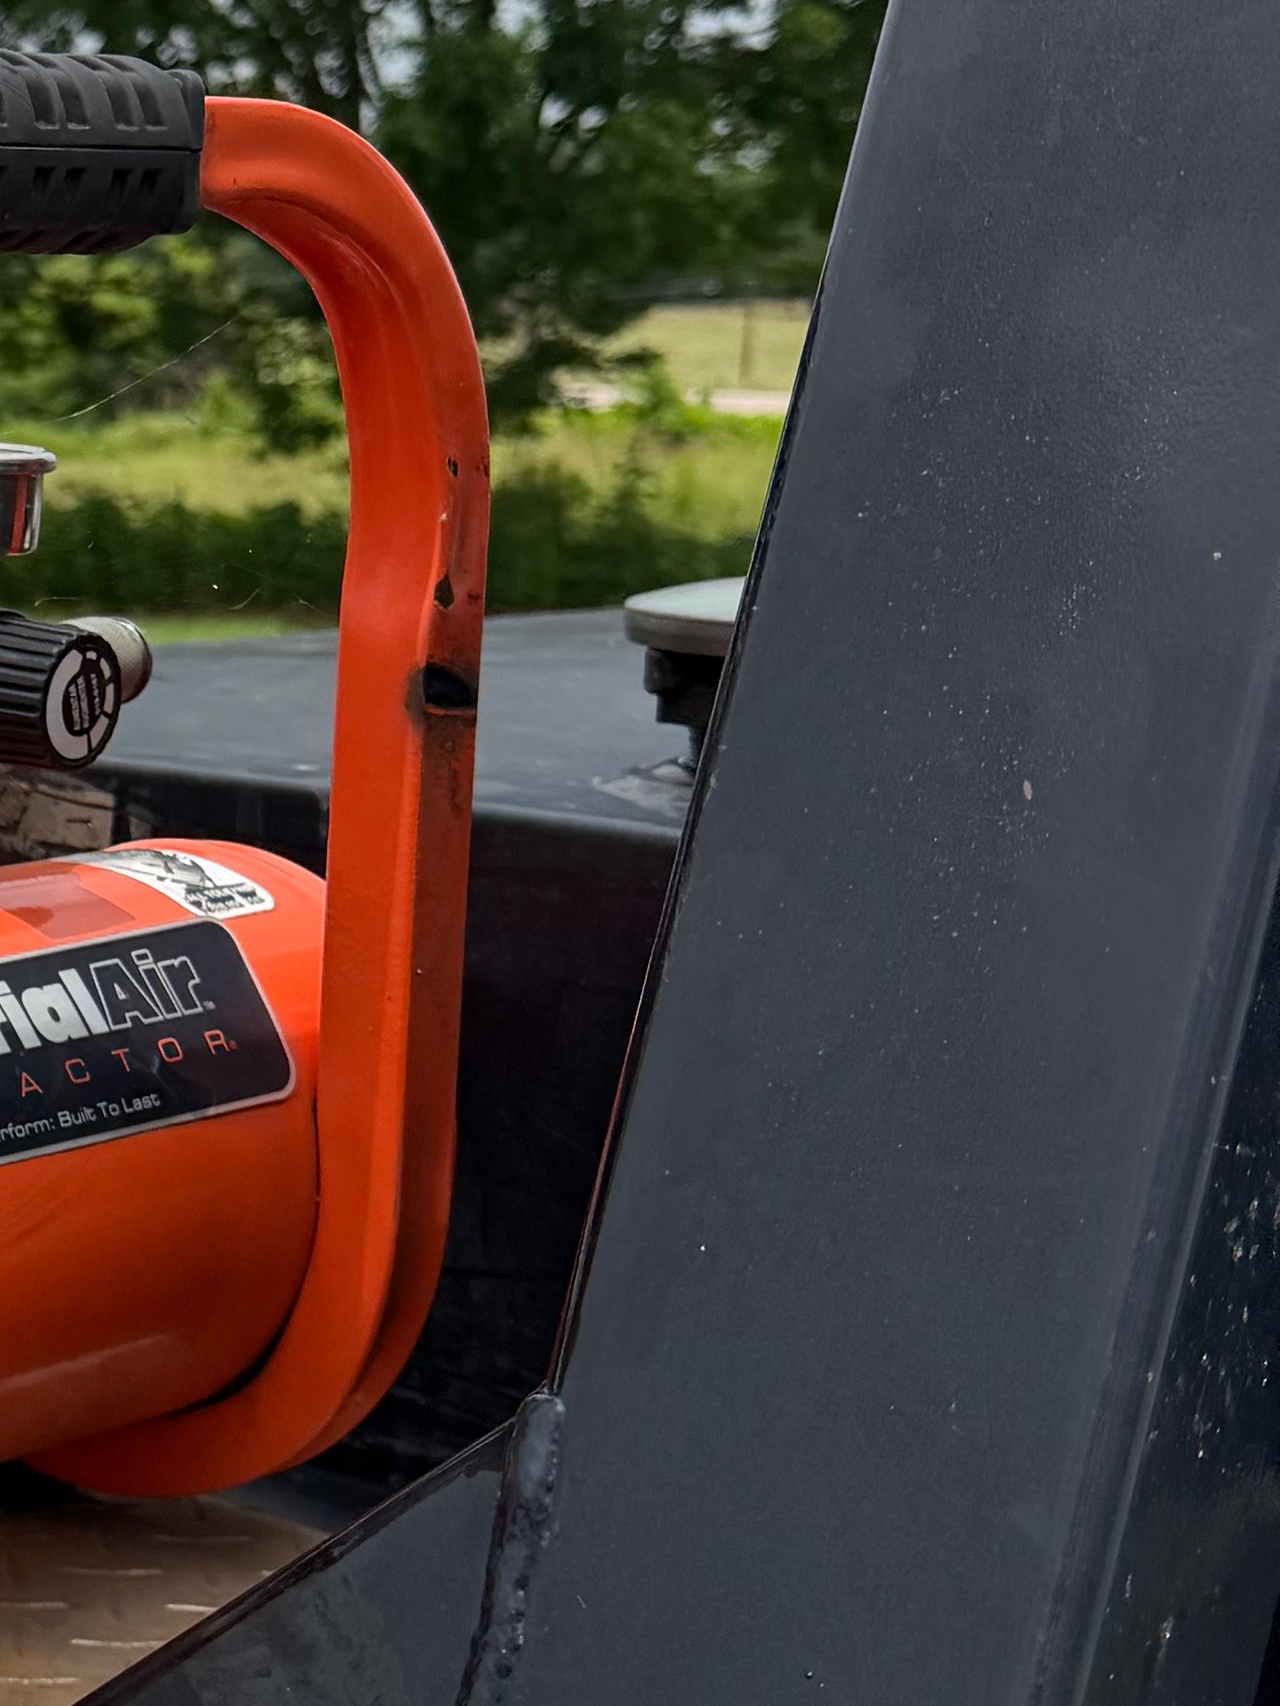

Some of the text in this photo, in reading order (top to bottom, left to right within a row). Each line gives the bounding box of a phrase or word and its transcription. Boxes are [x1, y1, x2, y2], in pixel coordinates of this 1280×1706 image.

[57, 1106, 97, 1129] Built
[97, 1100, 120, 1118] To
[121, 1093, 163, 1114] Last
